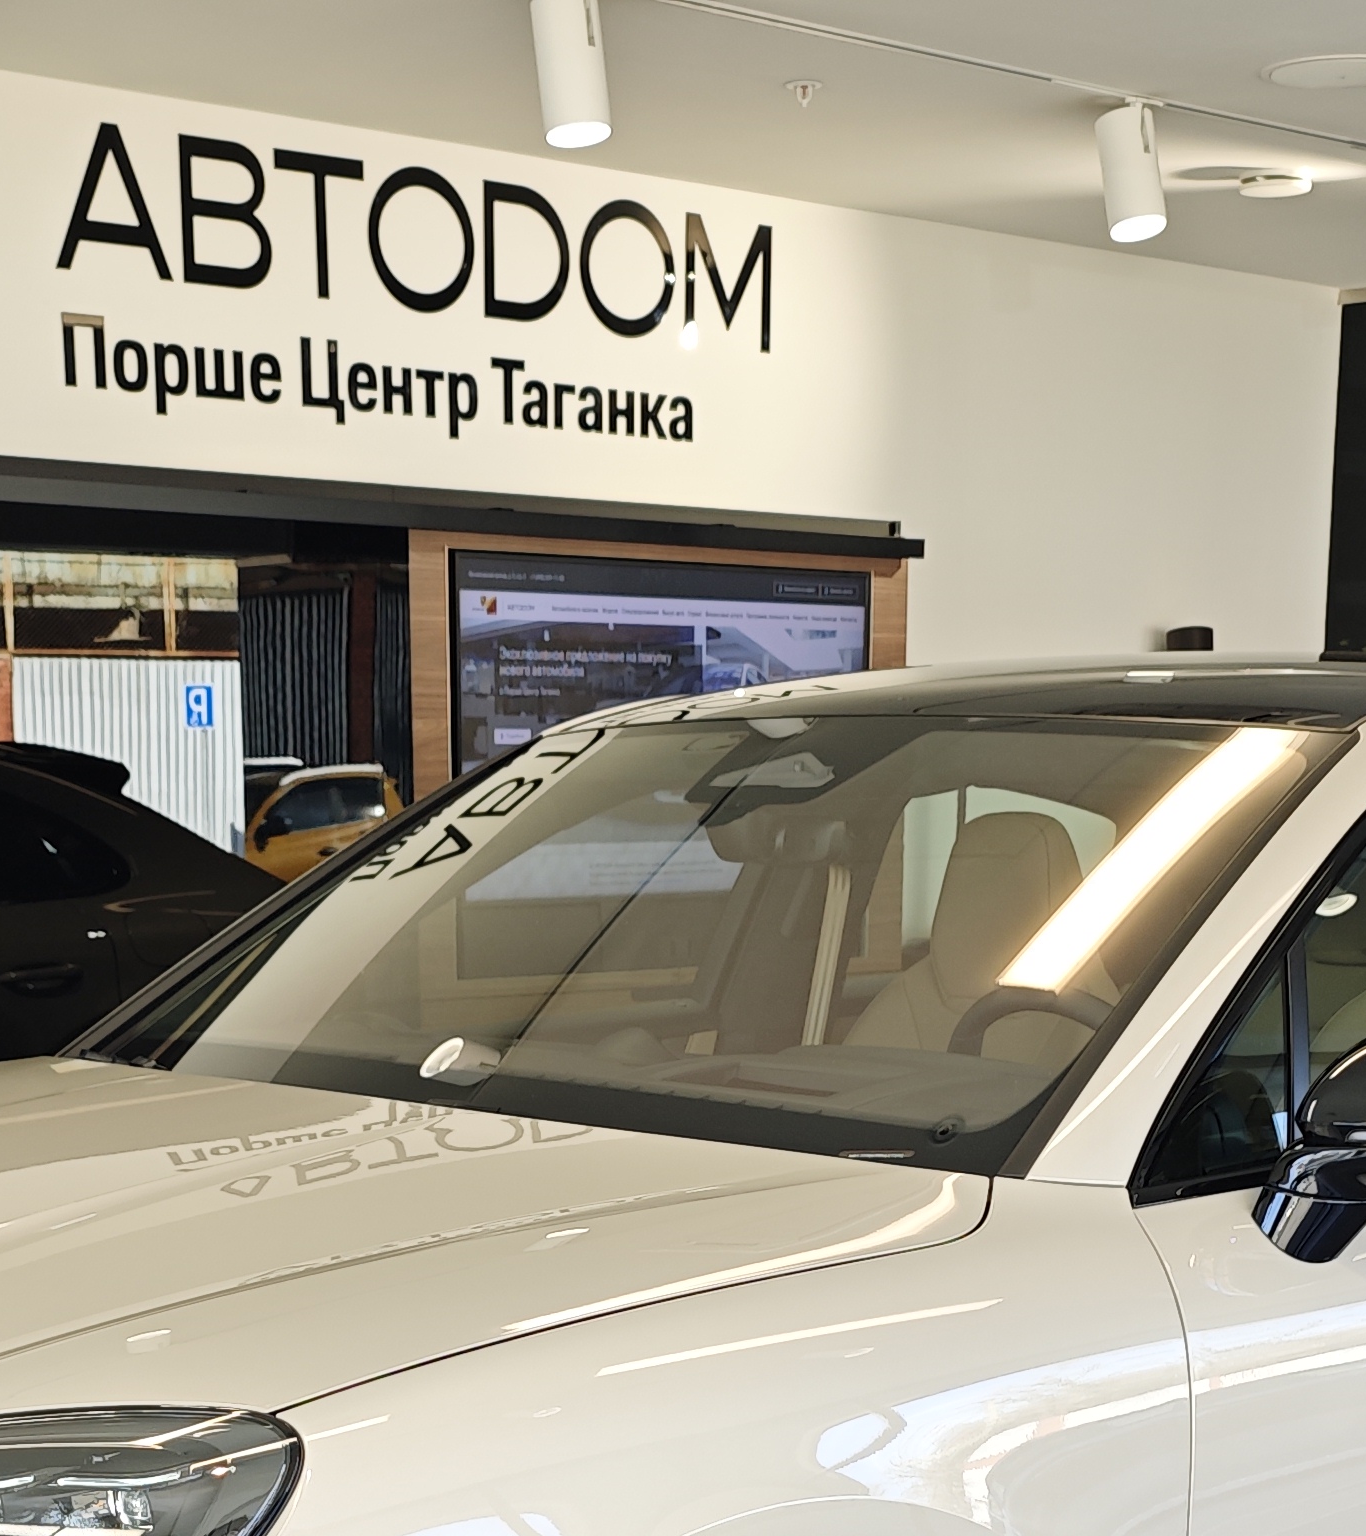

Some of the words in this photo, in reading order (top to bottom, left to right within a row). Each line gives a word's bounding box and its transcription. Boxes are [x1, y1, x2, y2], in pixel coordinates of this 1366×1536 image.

[60, 312, 282, 414] Порше
[300, 336, 478, 439] Центр
[490, 357, 695, 443] Таганка
